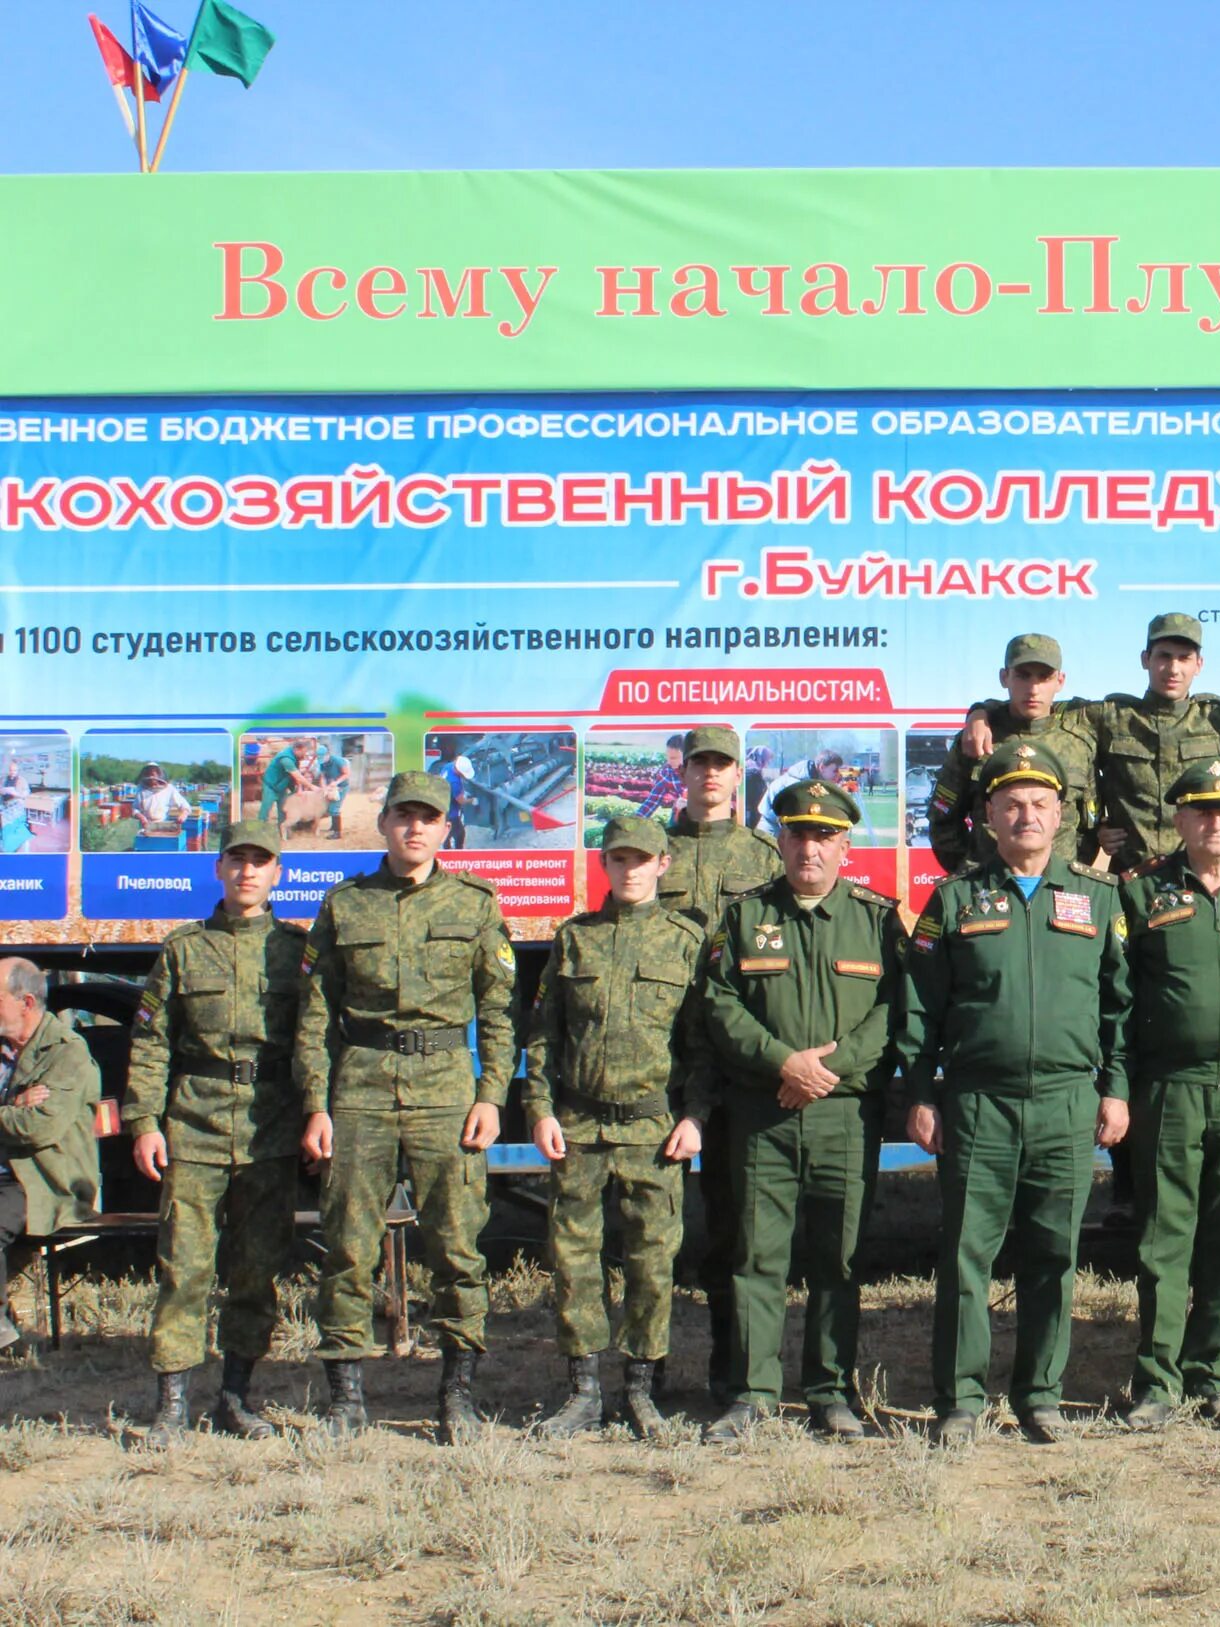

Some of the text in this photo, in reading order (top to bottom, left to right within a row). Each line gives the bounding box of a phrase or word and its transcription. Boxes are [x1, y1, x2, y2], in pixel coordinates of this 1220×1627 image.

[213, 241, 558, 338] Всему
[160, 416, 415, 445] БЮДЖЕТНОЕ
[427, 411, 858, 440] ПРОФЕССИОНАЛЬНОЕ
[14, 626, 82, 654] 1100
[92, 631, 257, 660] студентов
[267, 622, 655, 653] сельскохозяйственного
[665, 625, 888, 654] направления:
[618, 679, 881, 705] ПО СПЕЦИАЛЬНОСТЯМ:
[288, 867, 344, 884] Мастер
[526, 859, 567, 870] ремонт
[117, 875, 192, 891] Пчеловод
